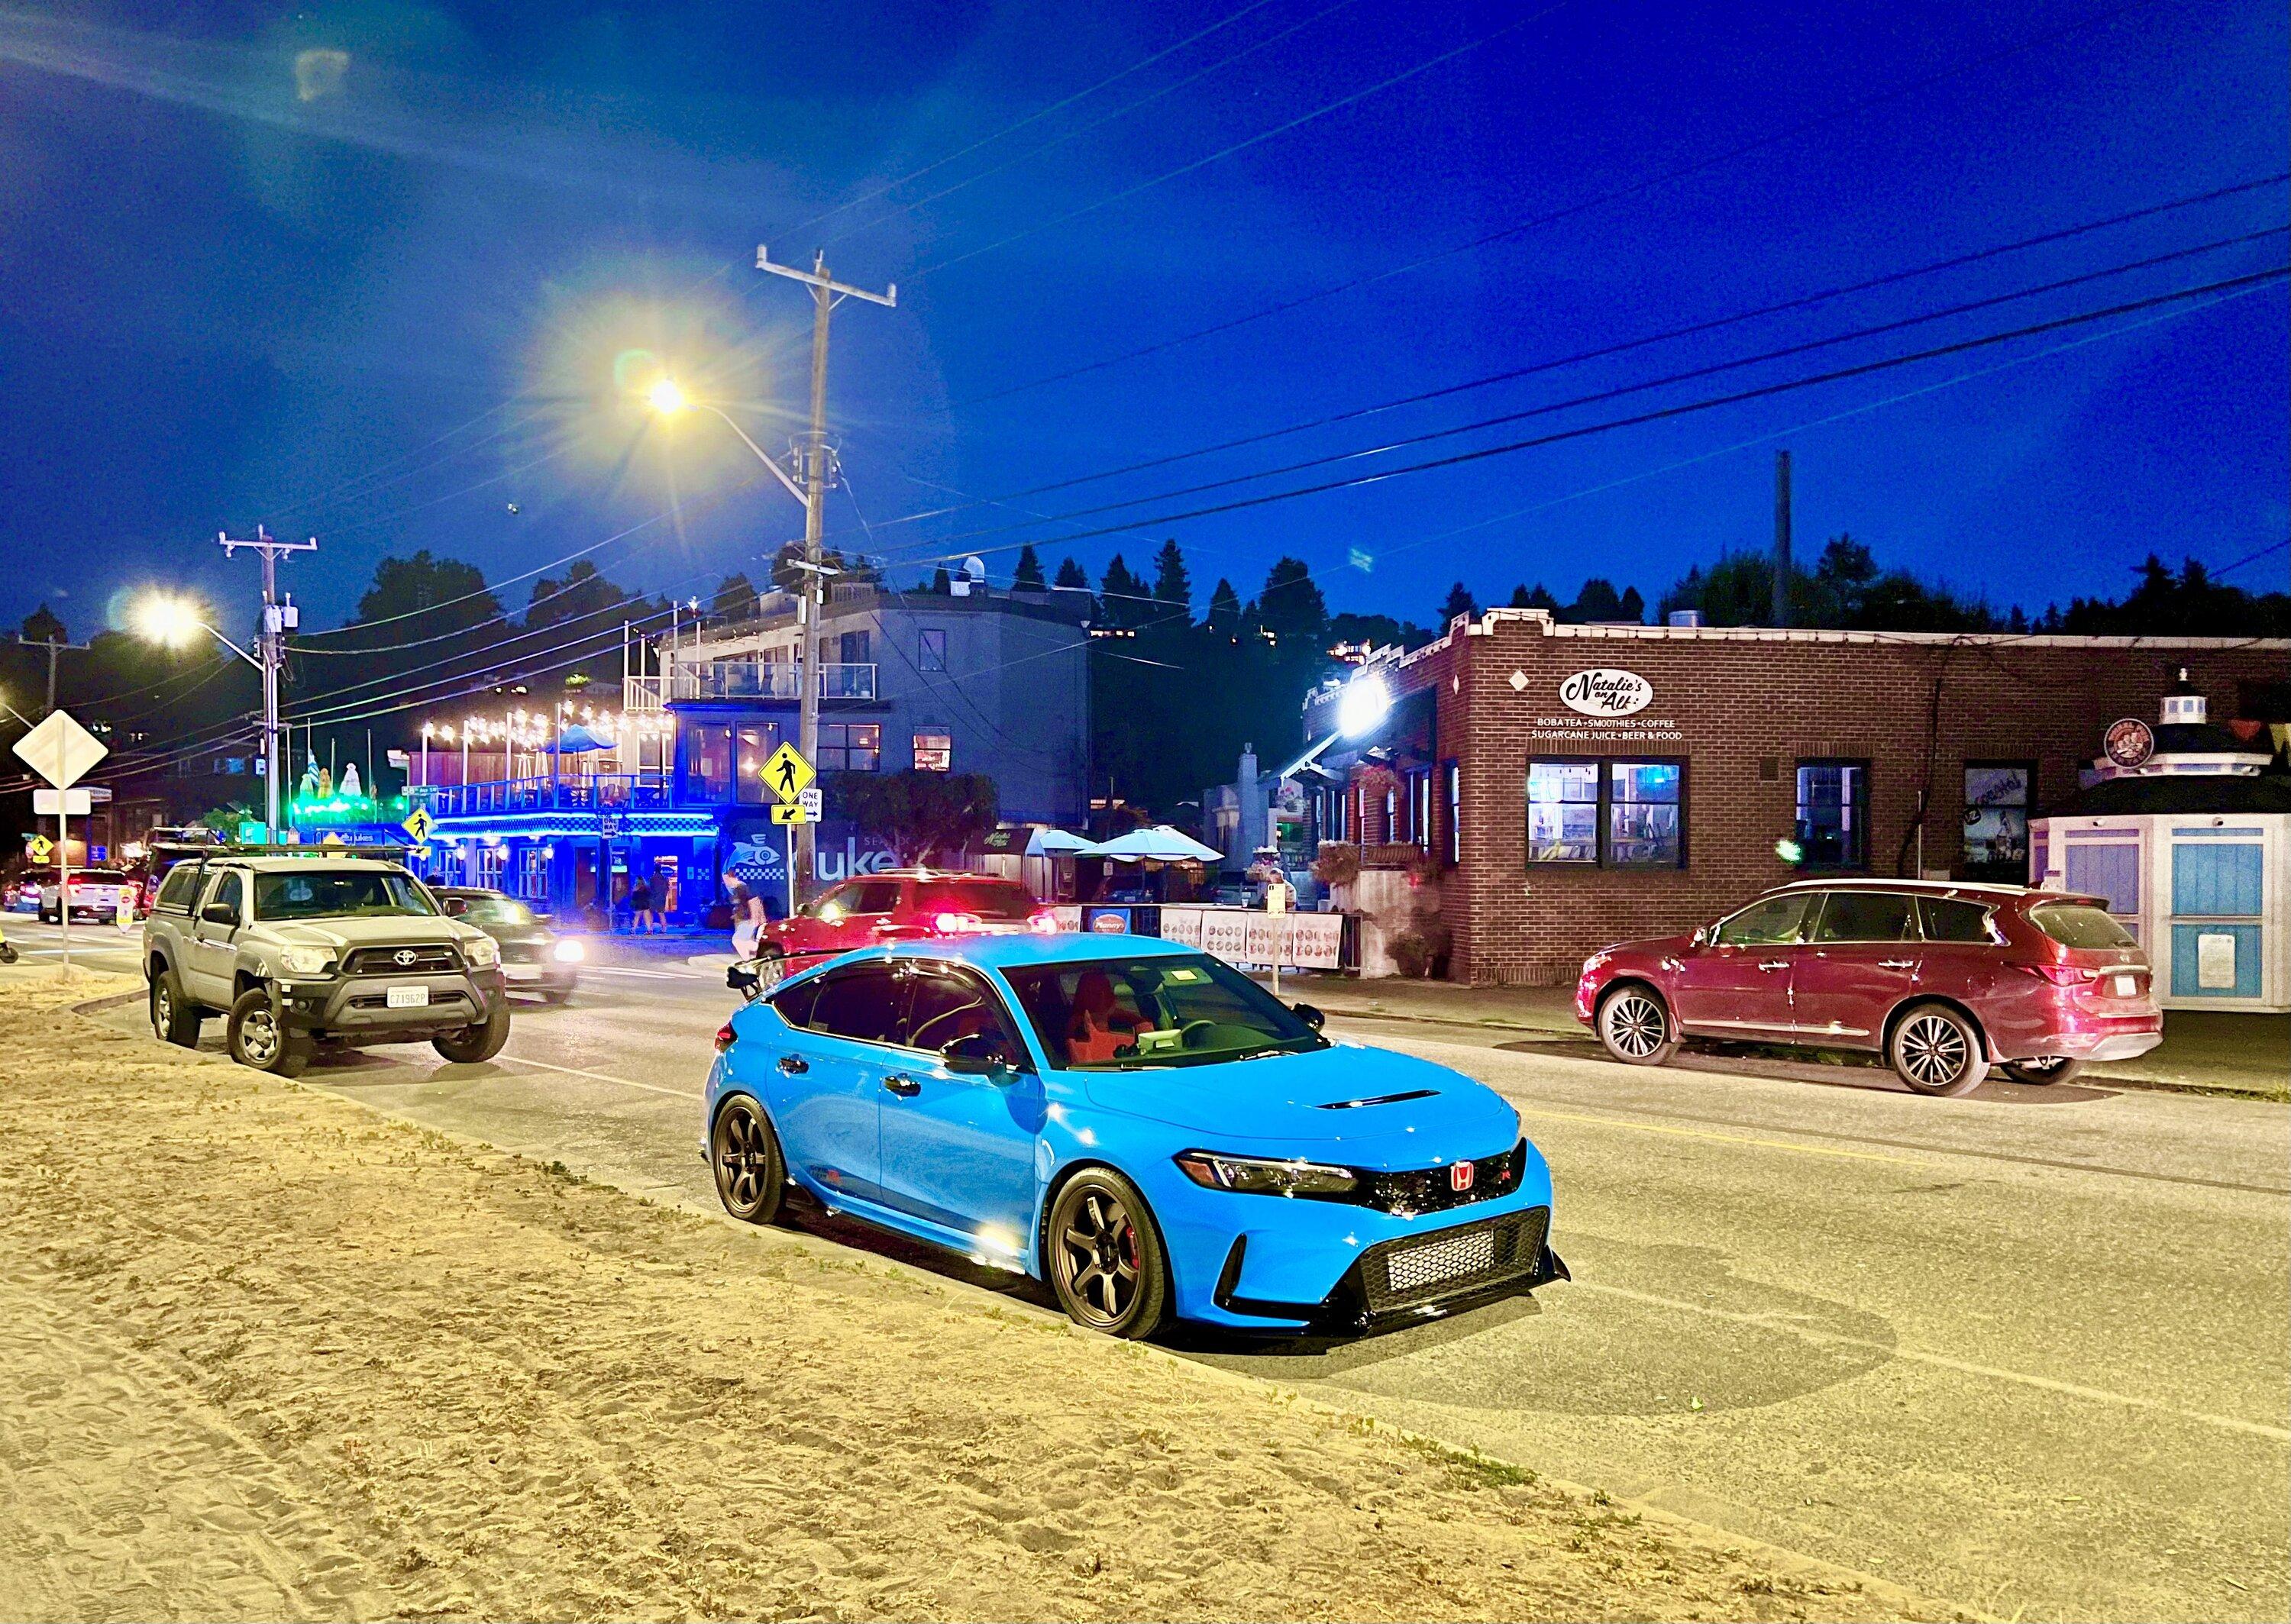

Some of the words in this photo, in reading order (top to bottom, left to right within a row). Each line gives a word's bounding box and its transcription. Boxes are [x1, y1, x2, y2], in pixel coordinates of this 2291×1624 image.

[1566, 672, 1642, 700] Natalie's
[1537, 718, 1563, 726] BOBA
[1588, 719, 1636, 728] SMOOTHIES
[1531, 730, 1589, 738] SUGARCANE
[1656, 731, 1682, 740] FOOD
[803, 791, 818, 799] ONE
